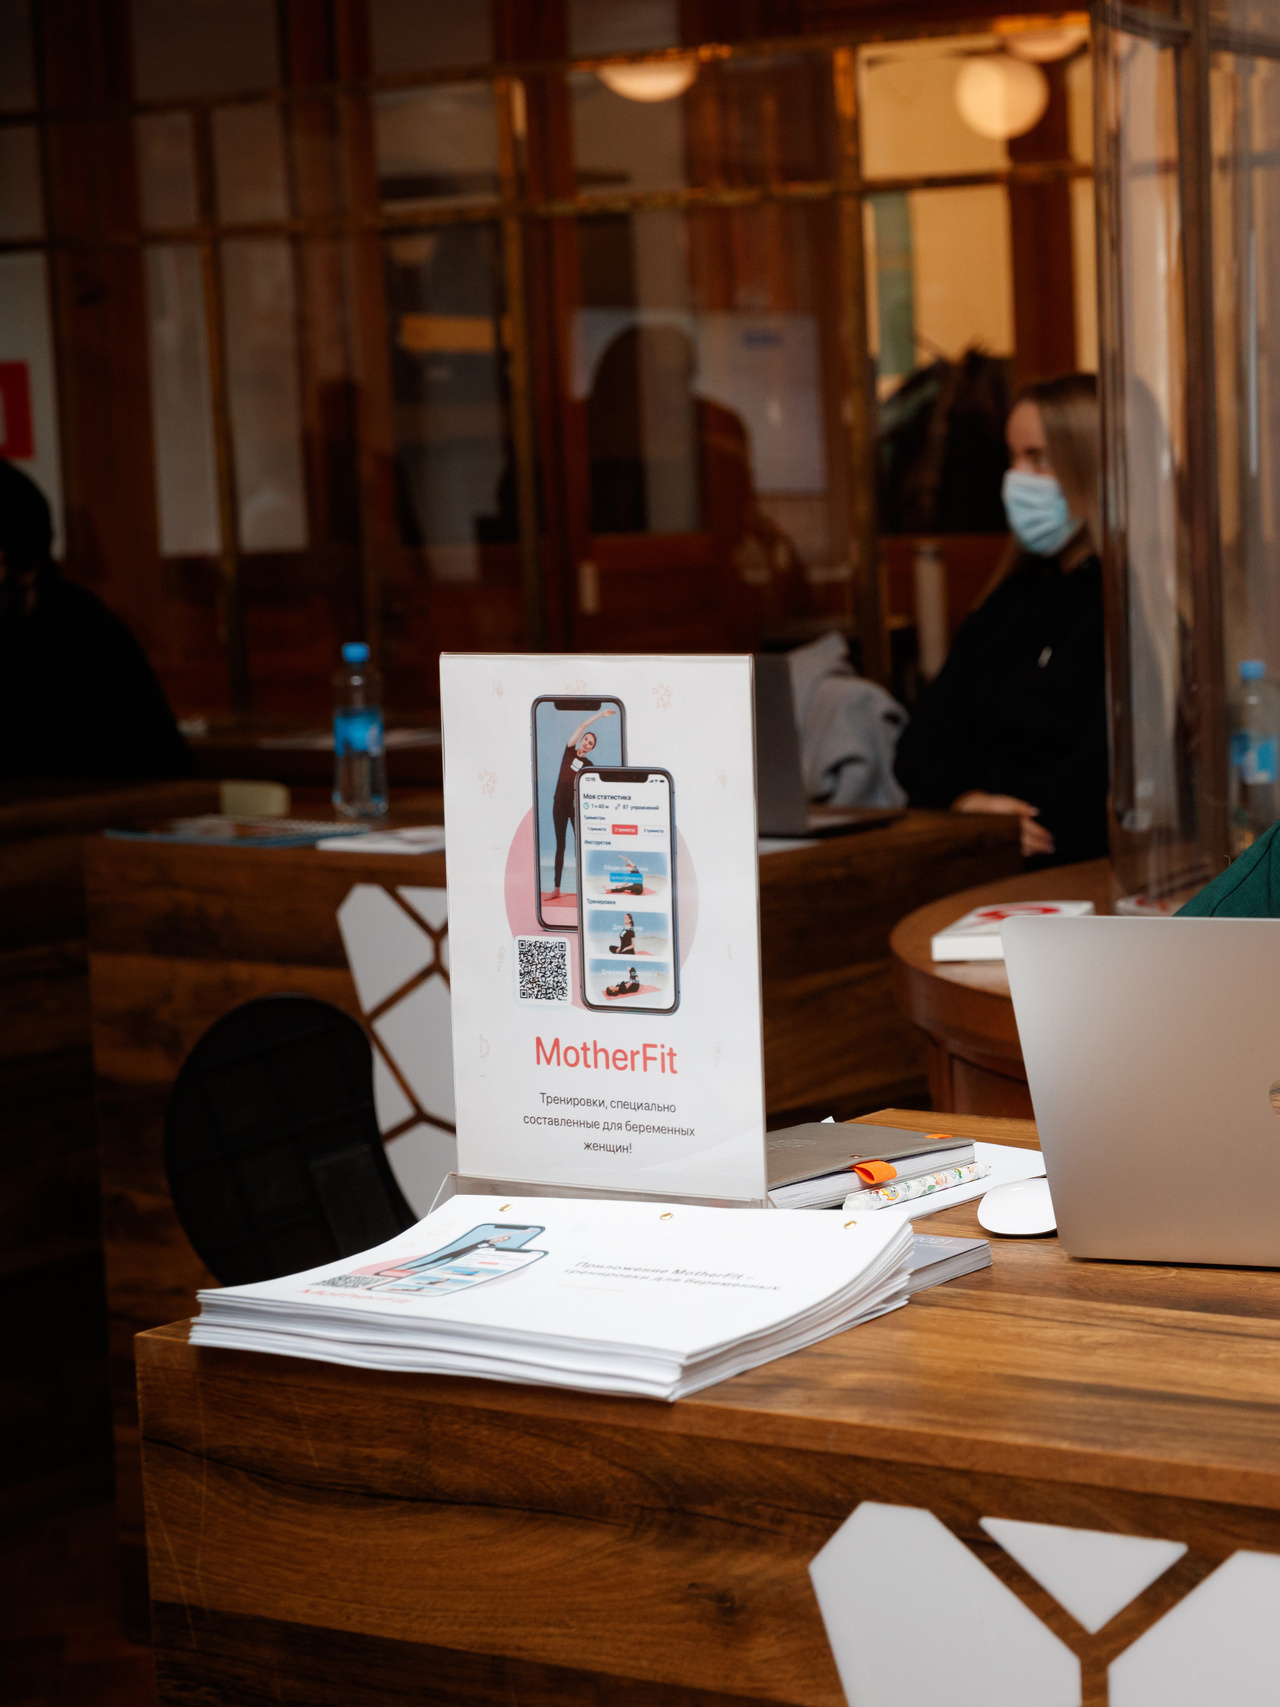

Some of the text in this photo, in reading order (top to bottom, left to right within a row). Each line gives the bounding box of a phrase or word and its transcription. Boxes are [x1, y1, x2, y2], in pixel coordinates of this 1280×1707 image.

[535, 1036, 678, 1075] MotherFit
[539, 1092, 677, 1113] Тренировки, специально
[523, 1114, 696, 1137] составленные для беременных
[583, 1141, 632, 1154] женщин!
[563, 1268, 650, 1281] тренировки
[574, 1261, 669, 1275] Приложение
[671, 1268, 744, 1279] MotherFit
